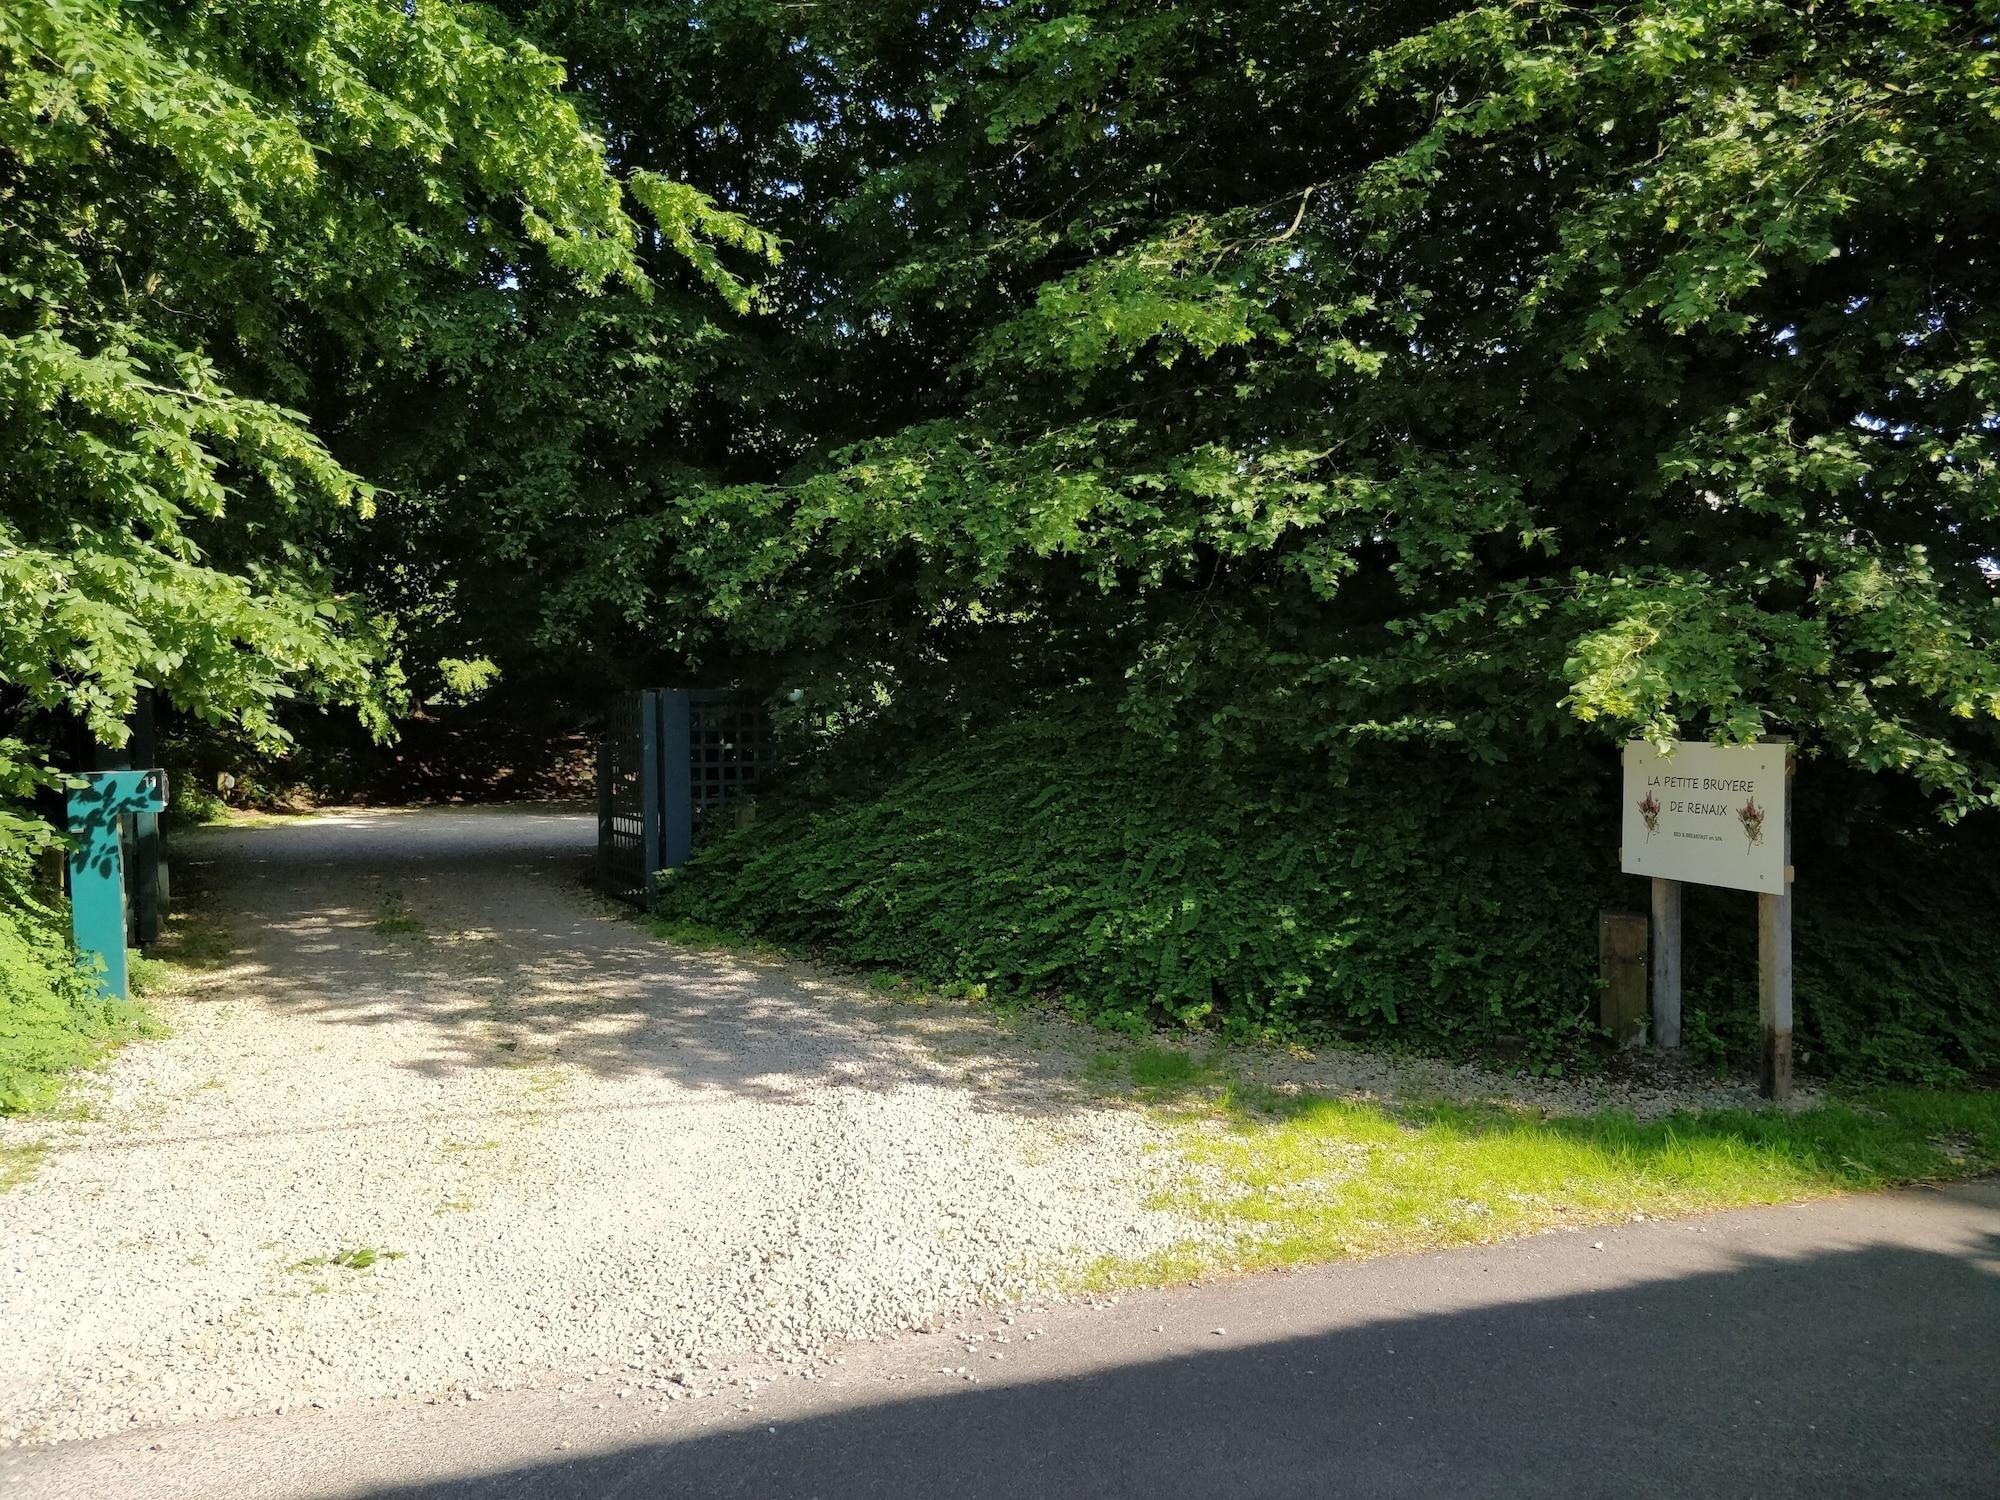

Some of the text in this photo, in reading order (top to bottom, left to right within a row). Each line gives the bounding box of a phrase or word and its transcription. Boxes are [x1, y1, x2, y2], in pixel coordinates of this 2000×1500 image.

[142, 776, 157, 788] 11
[1647, 776, 1754, 793] LA PETITE BRUYERE
[1670, 801, 1728, 816] DE RENAIX
